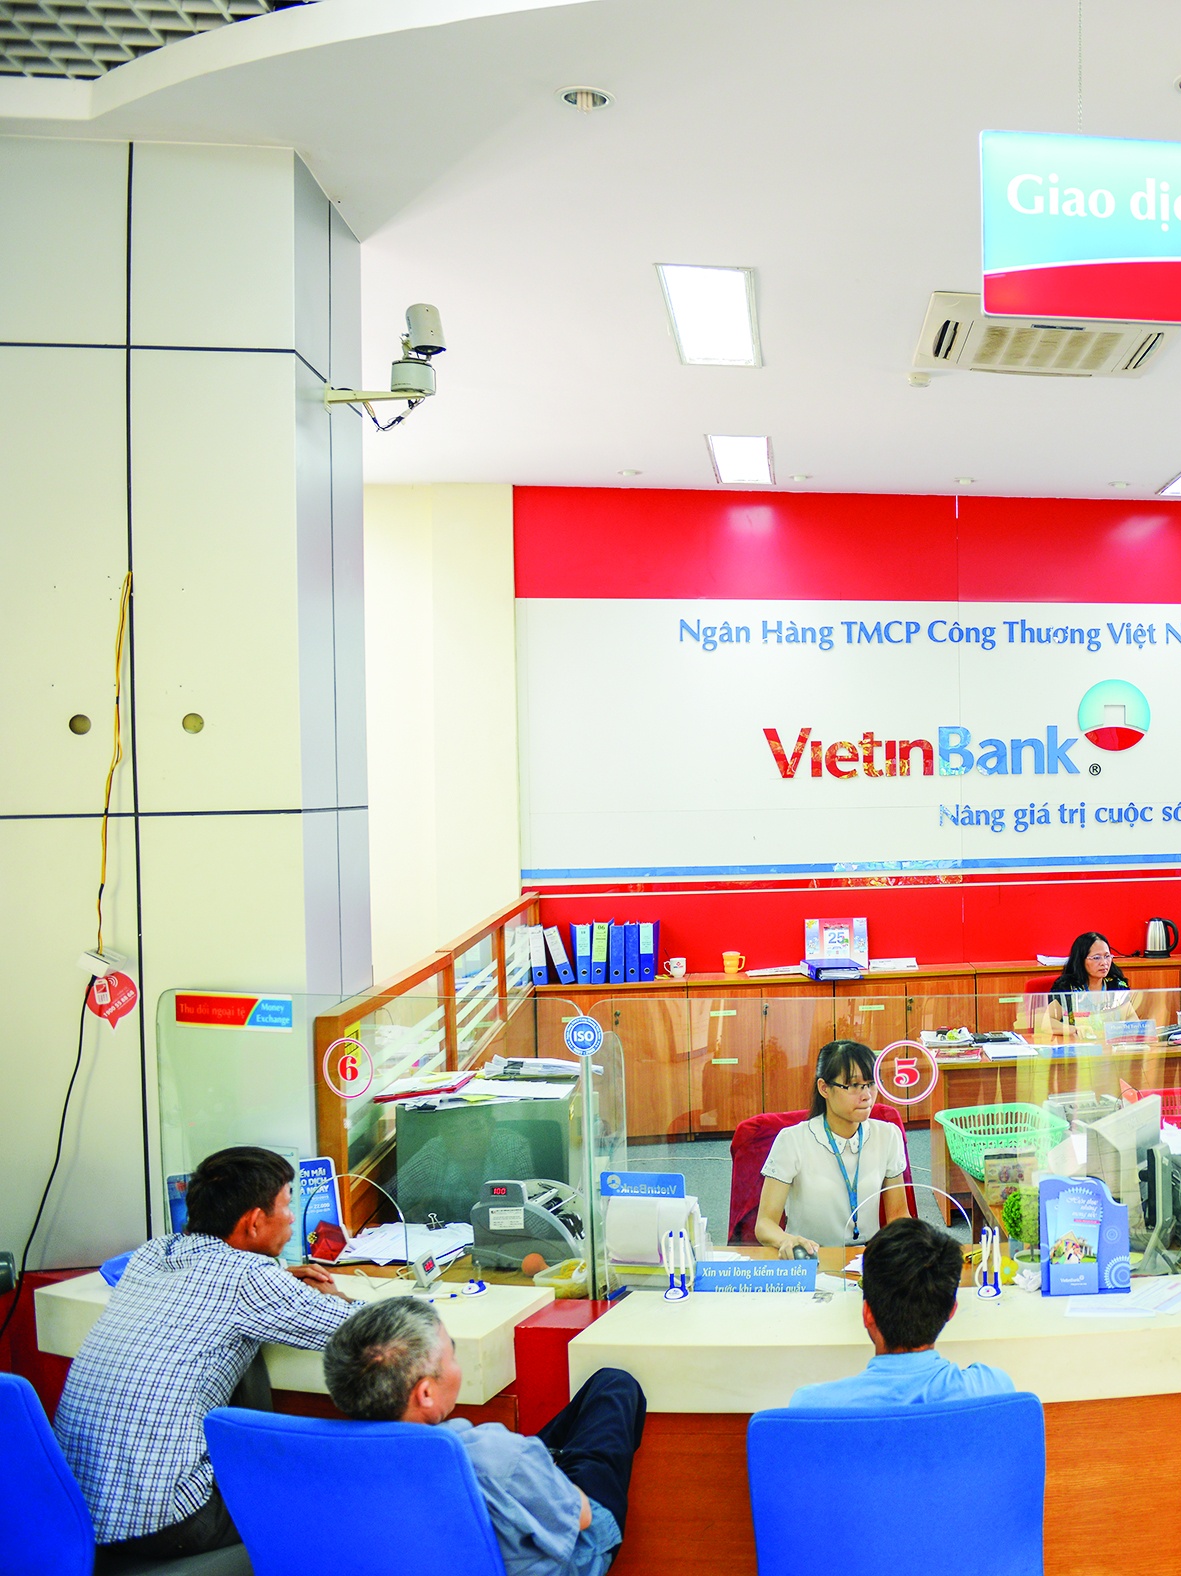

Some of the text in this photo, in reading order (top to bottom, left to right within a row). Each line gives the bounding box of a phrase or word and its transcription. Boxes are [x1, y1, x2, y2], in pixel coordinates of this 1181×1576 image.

[1007, 173, 1116, 219] Giao
[679, 619, 751, 653] Ngân
[762, 620, 834, 651] Hàng
[841, 621, 921, 645] TMCP
[927, 620, 997, 651] Công
[1002, 620, 1101, 652] Thương
[1106, 621, 1158, 651] Việt
[762, 724, 1081, 780] VietinBank
[939, 803, 1006, 833] Nâng
[1013, 803, 1052, 832] giá
[1057, 801, 1087, 827] trị
[1094, 803, 1154, 826] cuộc
[828, 932, 845, 944] 25
[179, 1002, 246, 1018] Thu đổi ngoại tệ
[261, 1003, 285, 1014] Money
[256, 1014, 291, 1026] Exchange
[574, 1030, 595, 1042] ISO
[338, 1055, 359, 1082] 6
[894, 1057, 920, 1087] 5
[702, 1264, 808, 1280] Xin vui lòng kiểm tra tiền
